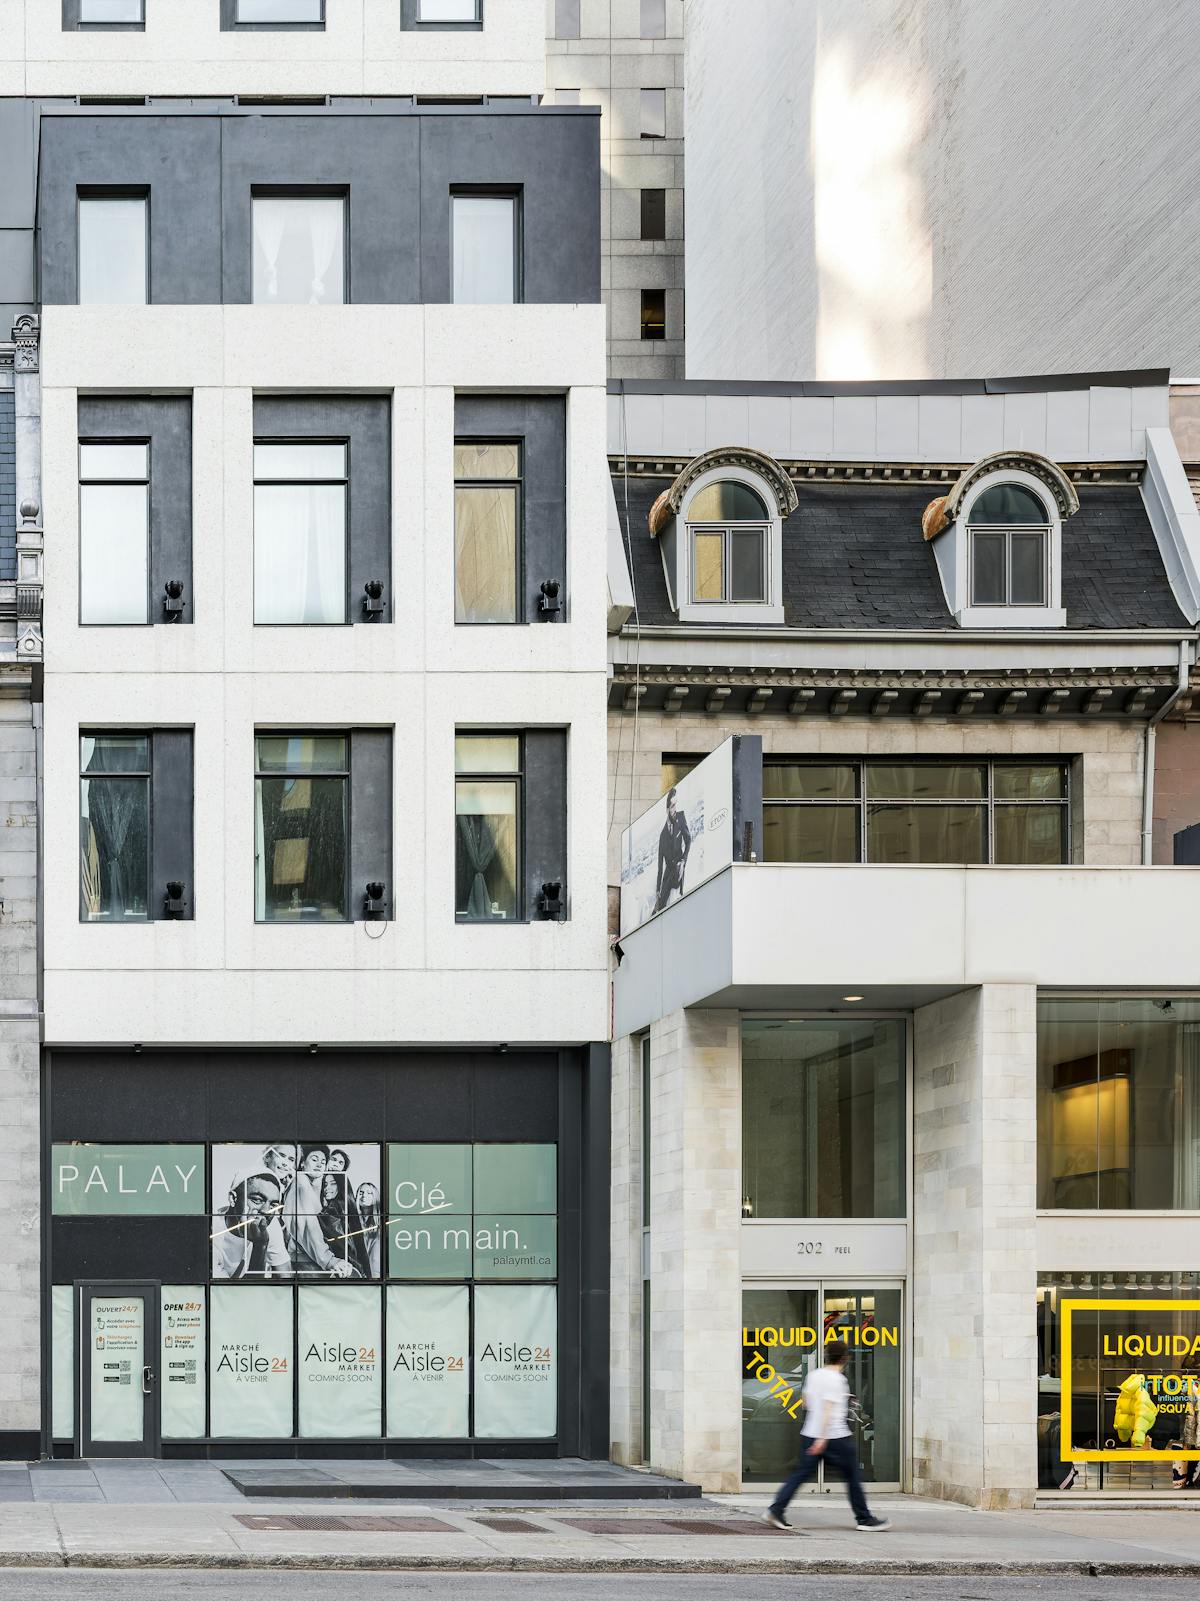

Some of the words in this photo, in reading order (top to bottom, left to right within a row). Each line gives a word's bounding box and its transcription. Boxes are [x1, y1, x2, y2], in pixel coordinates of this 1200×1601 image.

[59, 1165, 197, 1193] PALAY
[395, 1181, 445, 1209] Clé
[394, 1229, 431, 1250] en
[443, 1223, 527, 1250] main.
[797, 1242, 822, 1254] 202
[834, 1246, 851, 1254] PEEL
[493, 1255, 551, 1267] palaymtl.ca
[122, 1305, 138, 1313] 24/7
[163, 1303, 184, 1311] OPEN
[185, 1302, 201, 1311] 24/7
[742, 1326, 898, 1347] LIQUIDATION
[221, 1343, 260, 1352] MARCHÉ
[397, 1341, 436, 1350] MARCHÉ
[304, 1342, 357, 1362] Aisle
[358, 1347, 375, 1360] 24
[480, 1342, 532, 1362] Aisle
[534, 1347, 551, 1360] 24
[216, 1352, 269, 1373] Aisle
[271, 1357, 288, 1371] 24
[392, 1351, 445, 1372] Aisle
[447, 1356, 464, 1370] 24
[338, 1364, 376, 1372] MARKET
[236, 1374, 243, 1383] À
[244, 1375, 268, 1383] VENIR
[308, 1374, 345, 1382] COMING
[347, 1374, 373, 1382] SOON
[412, 1373, 419, 1382] À
[421, 1374, 444, 1382] VENIR
[484, 1374, 521, 1382] COMING
[523, 1374, 548, 1382] SOON
[745, 1350, 804, 1420] TOTAL
[1147, 1375, 1200, 1396] TOT
